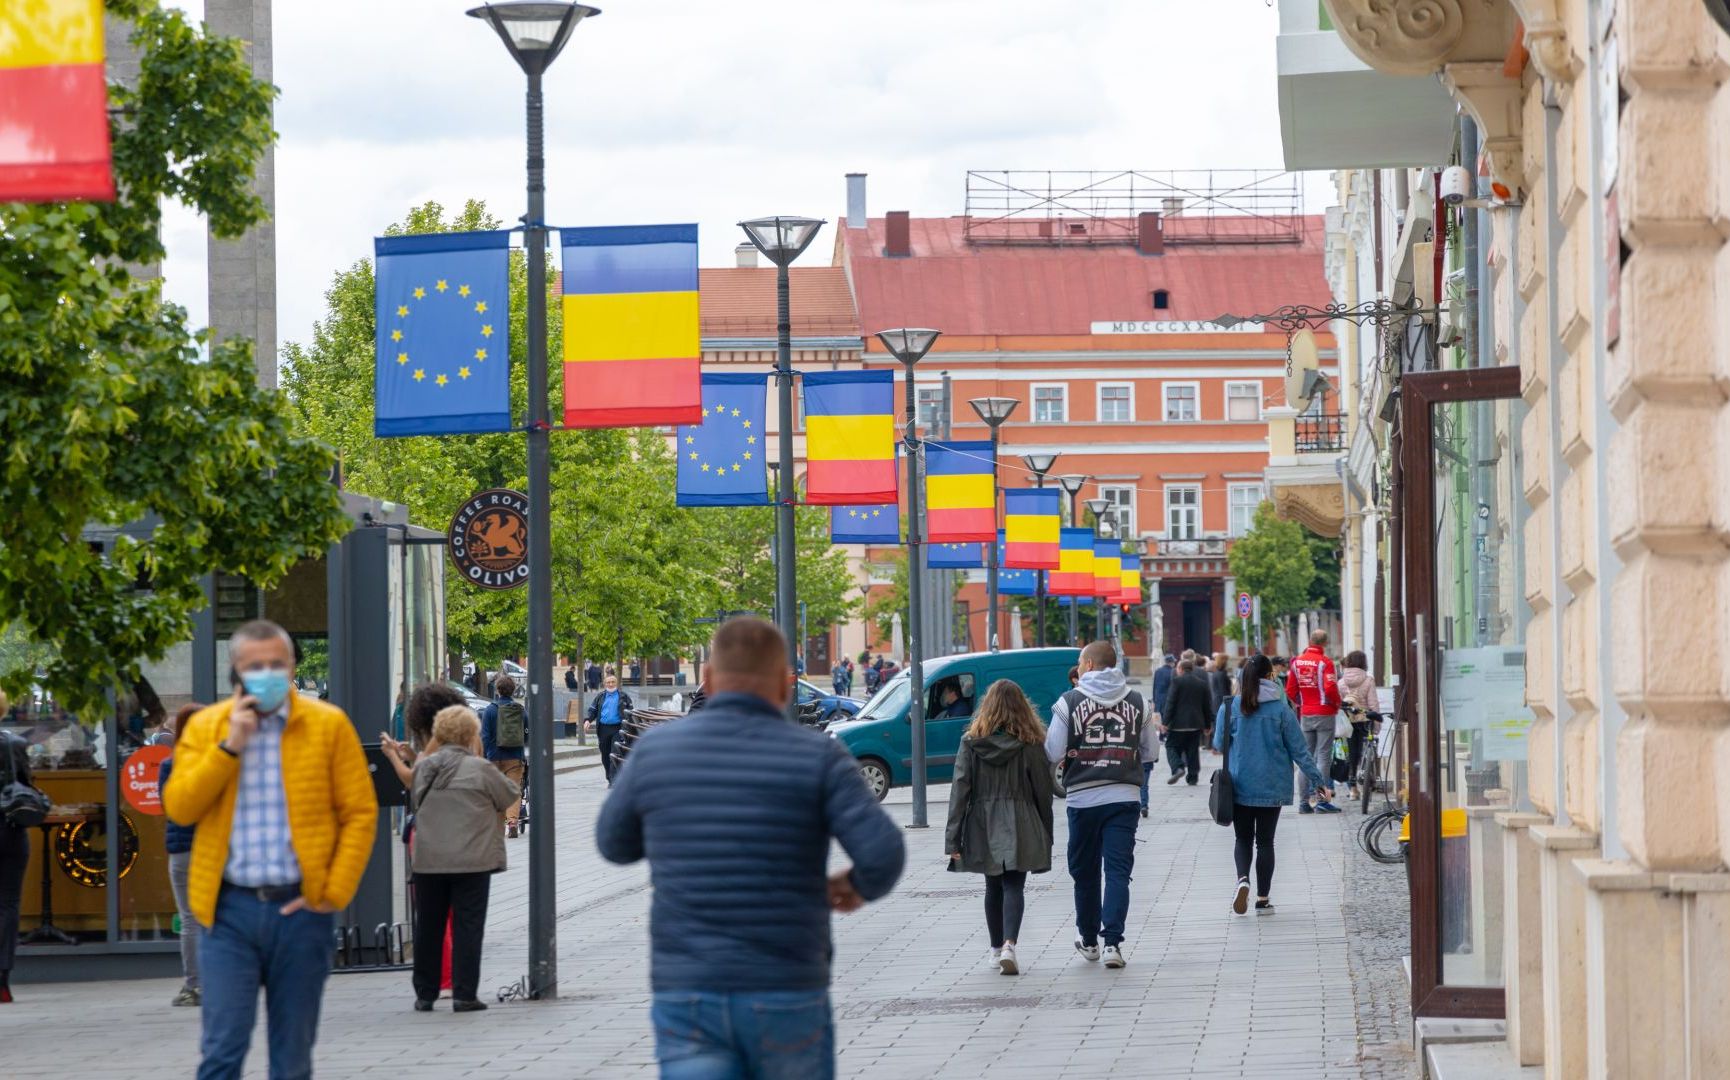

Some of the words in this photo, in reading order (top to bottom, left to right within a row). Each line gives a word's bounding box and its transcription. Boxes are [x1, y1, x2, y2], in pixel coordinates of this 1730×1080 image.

[453, 500, 483, 557] COFFEE
[469, 565, 529, 585] OLIVO
[1296, 659, 1318, 667] TOTAL
